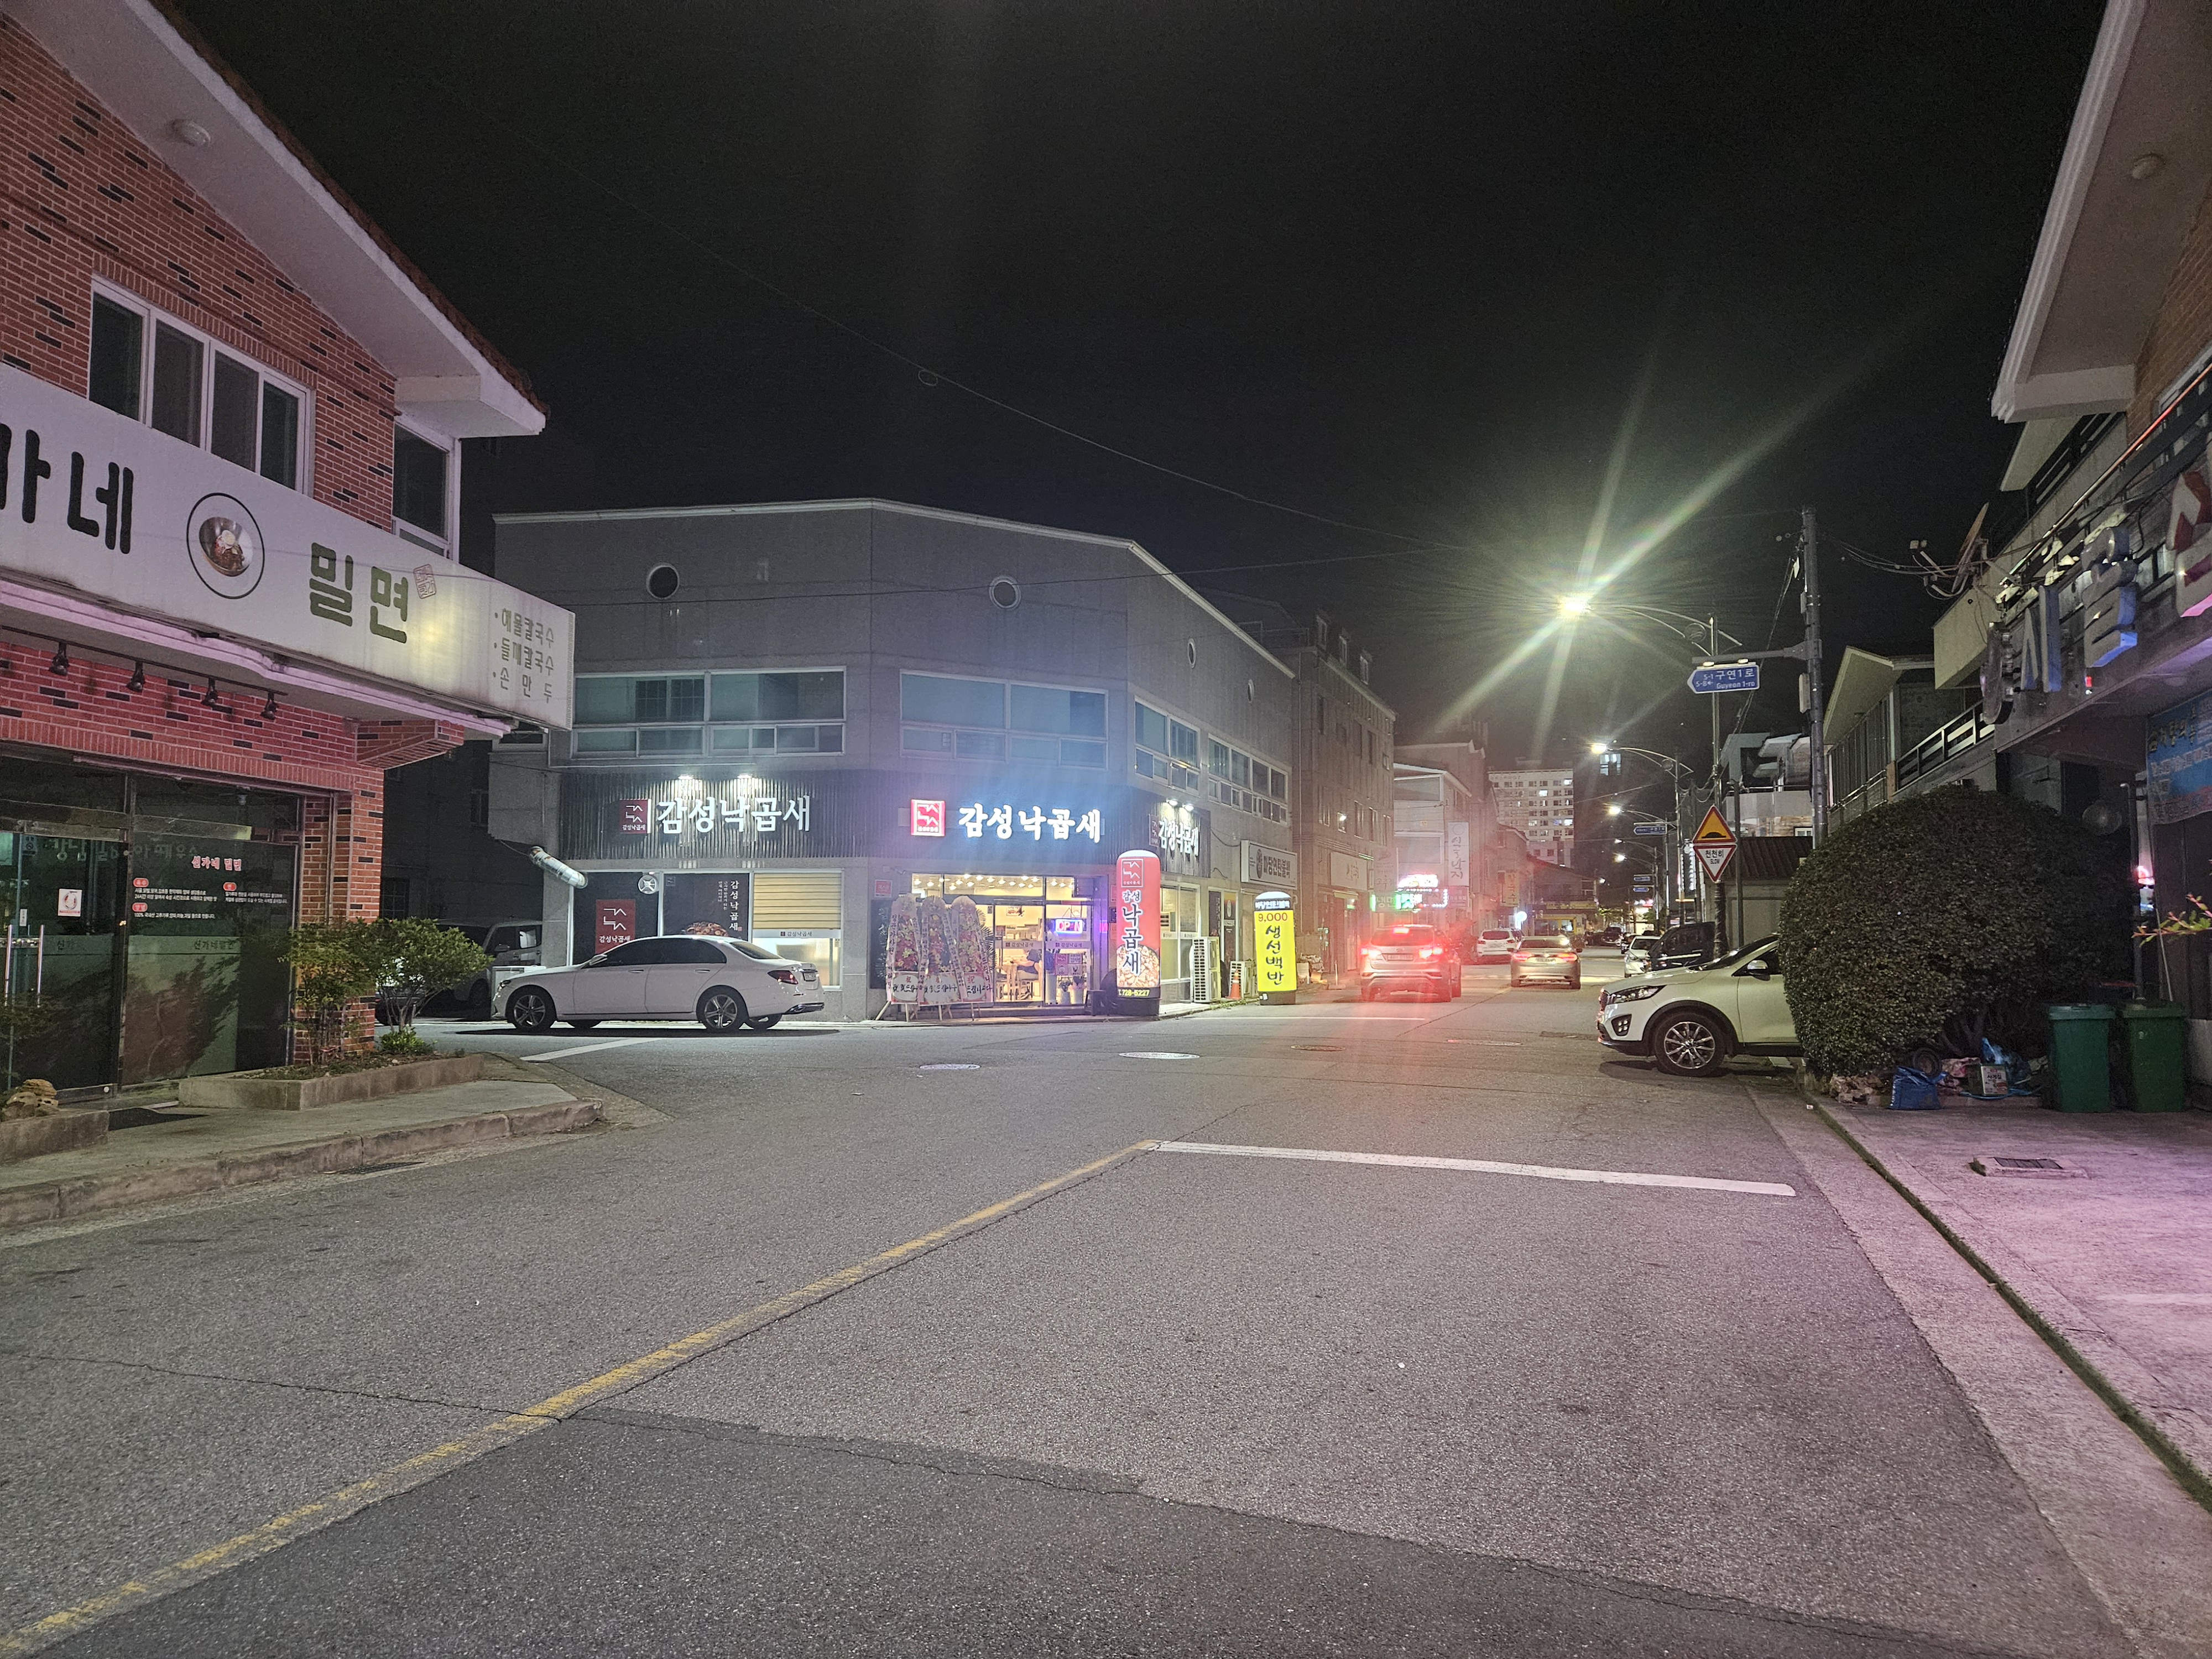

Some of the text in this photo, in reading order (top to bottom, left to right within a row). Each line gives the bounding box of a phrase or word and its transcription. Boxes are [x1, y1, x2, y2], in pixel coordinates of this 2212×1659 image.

[310, 542, 408, 644] 밀면
[502, 608, 554, 649] 해물칼국수
[501, 637, 554, 676] 들깨칼국수
[1715, 668, 1755, 680] 구연1로
[658, 795, 810, 834] 감성낙곱새
[958, 802, 1100, 843] 감성낙곱새
[1158, 817, 1199, 857] 감성낙곱새
[1705, 849, 1724, 858] 천천히
[224, 858, 242, 872] 밀면
[729, 880, 739, 931] 감성낙곱새
[1123, 890, 1140, 901] 감성
[1258, 912, 1288, 922] 9,000
[599, 935, 630, 943] 감성낙곱새
[1123, 904, 1142, 974] 낙곱새
[1265, 925, 1285, 985] 생선백반
